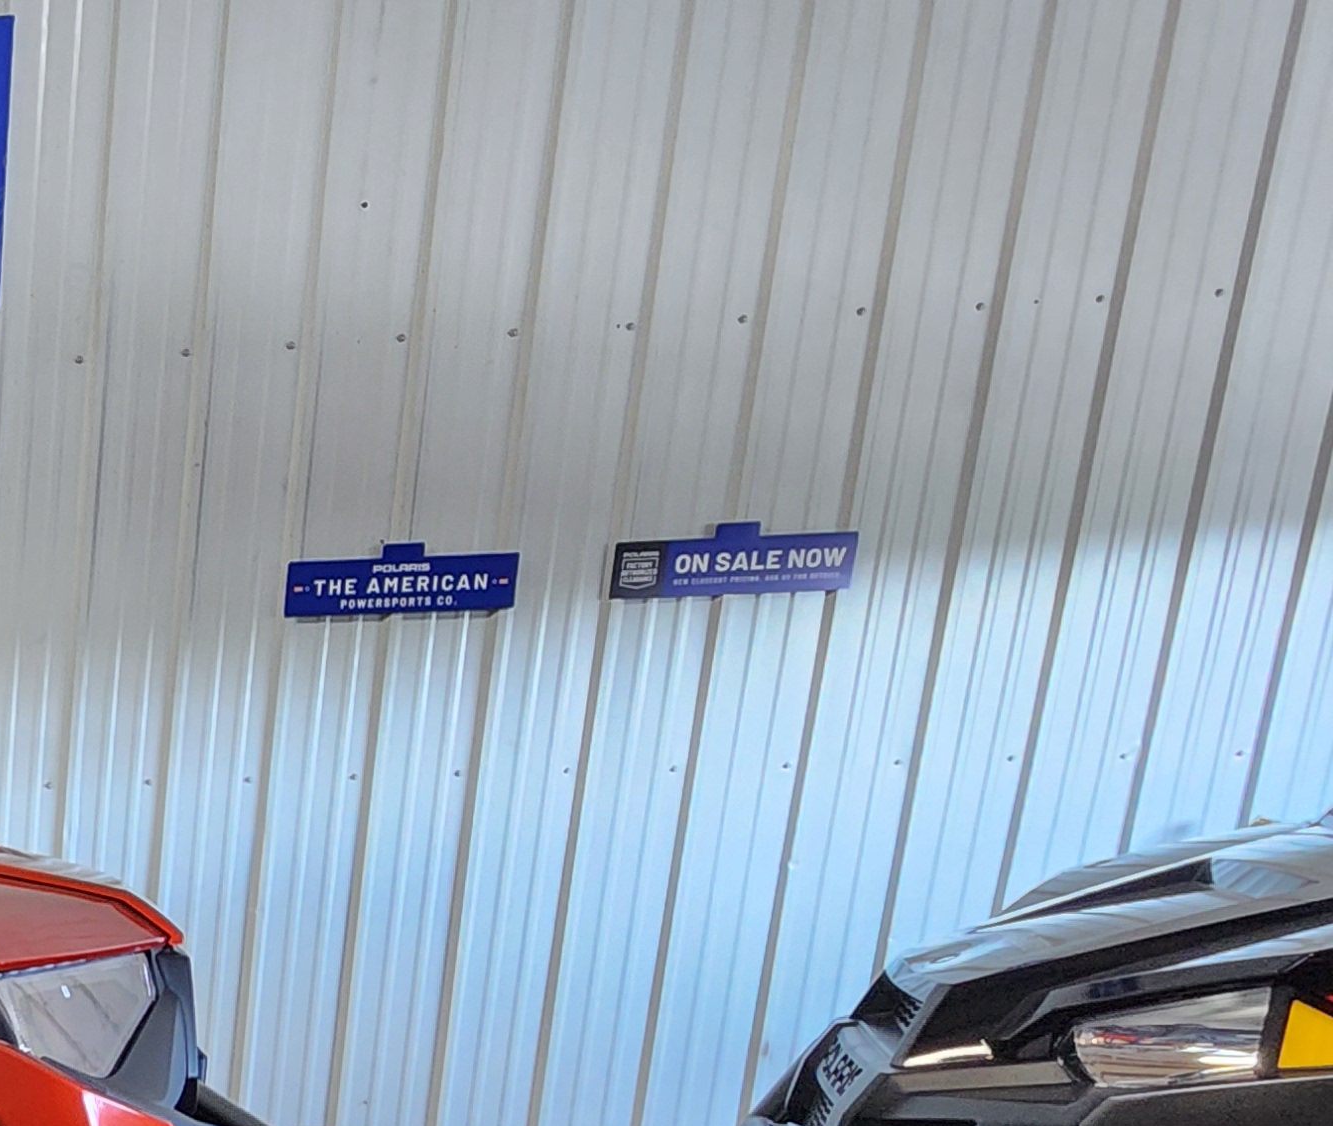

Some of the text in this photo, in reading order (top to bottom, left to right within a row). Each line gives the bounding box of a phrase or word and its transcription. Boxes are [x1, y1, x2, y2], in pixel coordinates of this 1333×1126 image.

[372, 562, 431, 574] POLARIS
[674, 547, 847, 574] ON SALE NOW
[313, 573, 489, 597] THE AMERICAN
[339, 595, 458, 610] POWERSPORTS CO.
